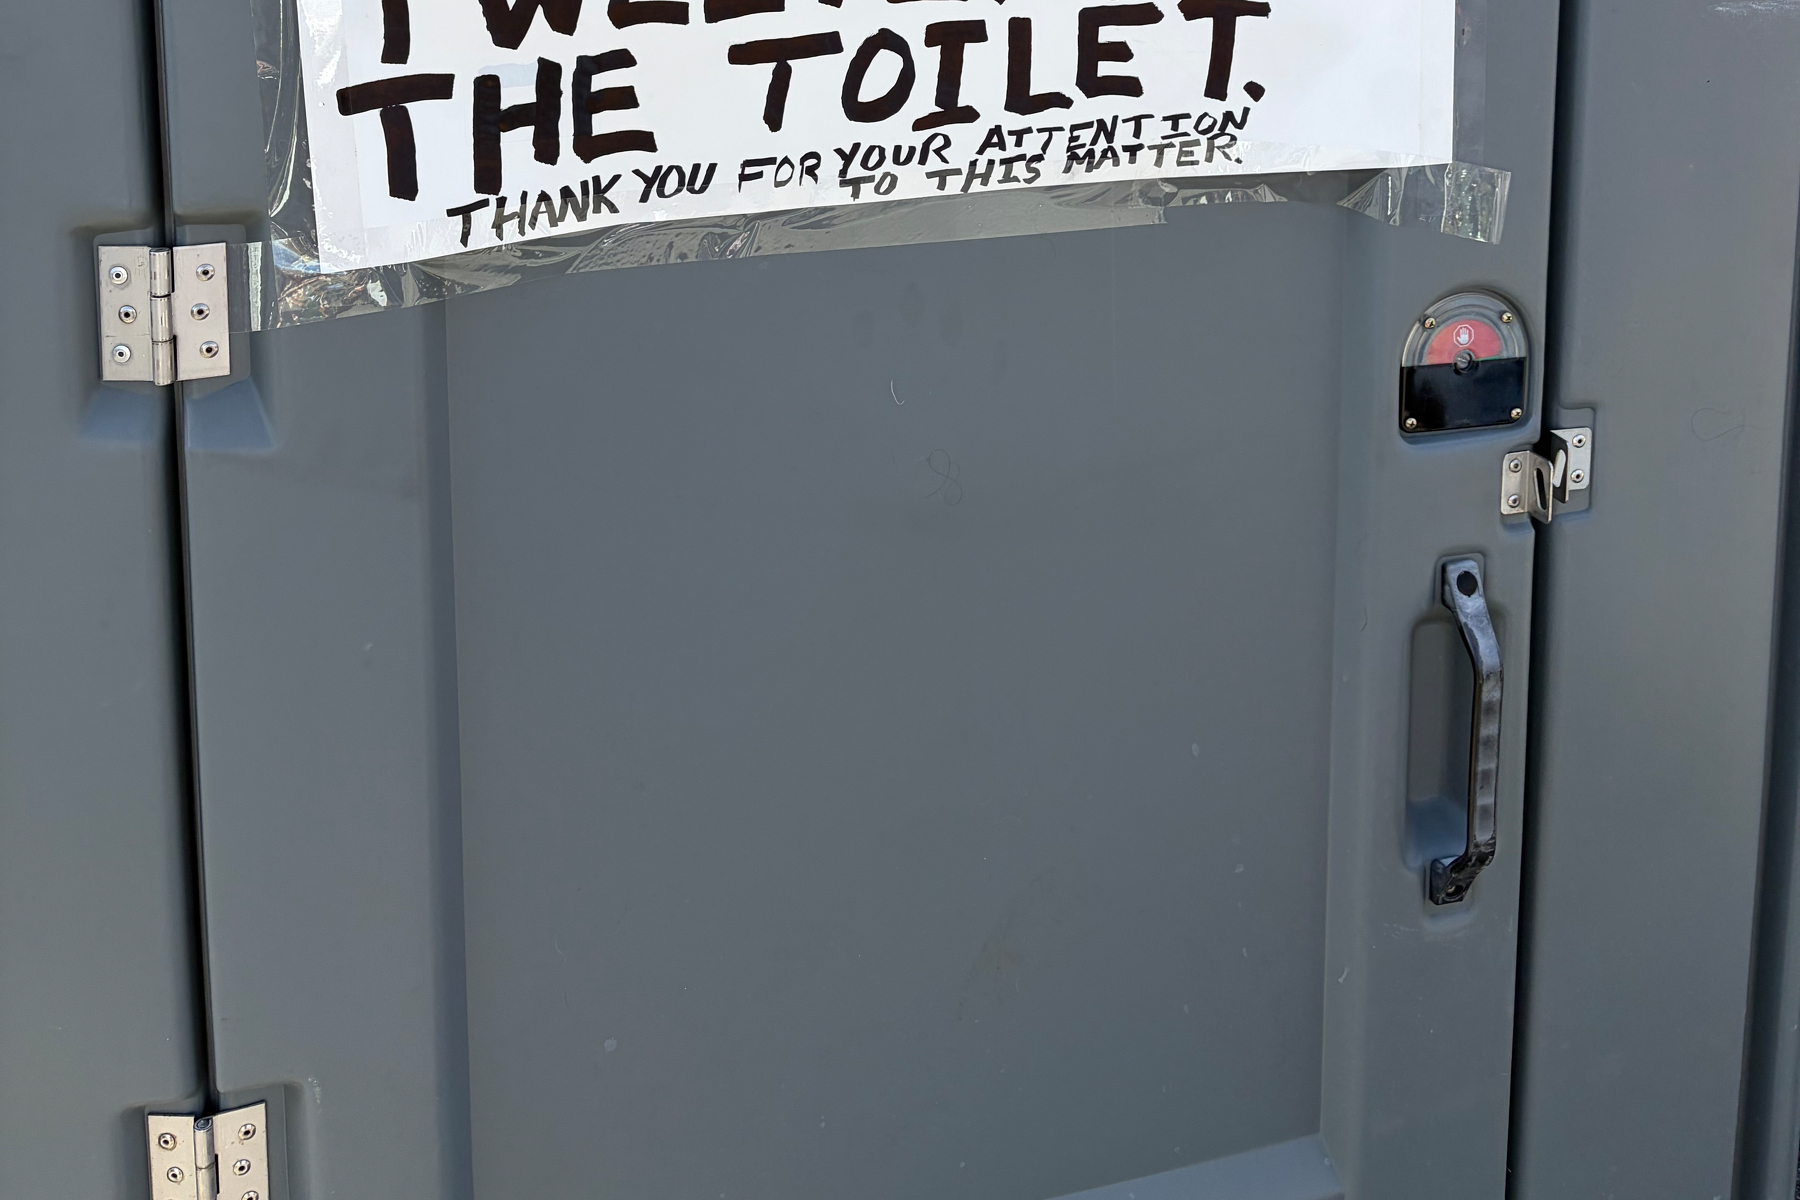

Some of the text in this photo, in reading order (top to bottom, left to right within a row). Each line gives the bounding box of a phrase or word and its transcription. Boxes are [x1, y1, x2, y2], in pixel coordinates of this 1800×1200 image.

[336, 49, 658, 201] THE
[446, 106, 1250, 248] THANK YOU FOR YOUR ATTENTION
[840, 133, 1243, 201] TO THIS MATTER.
